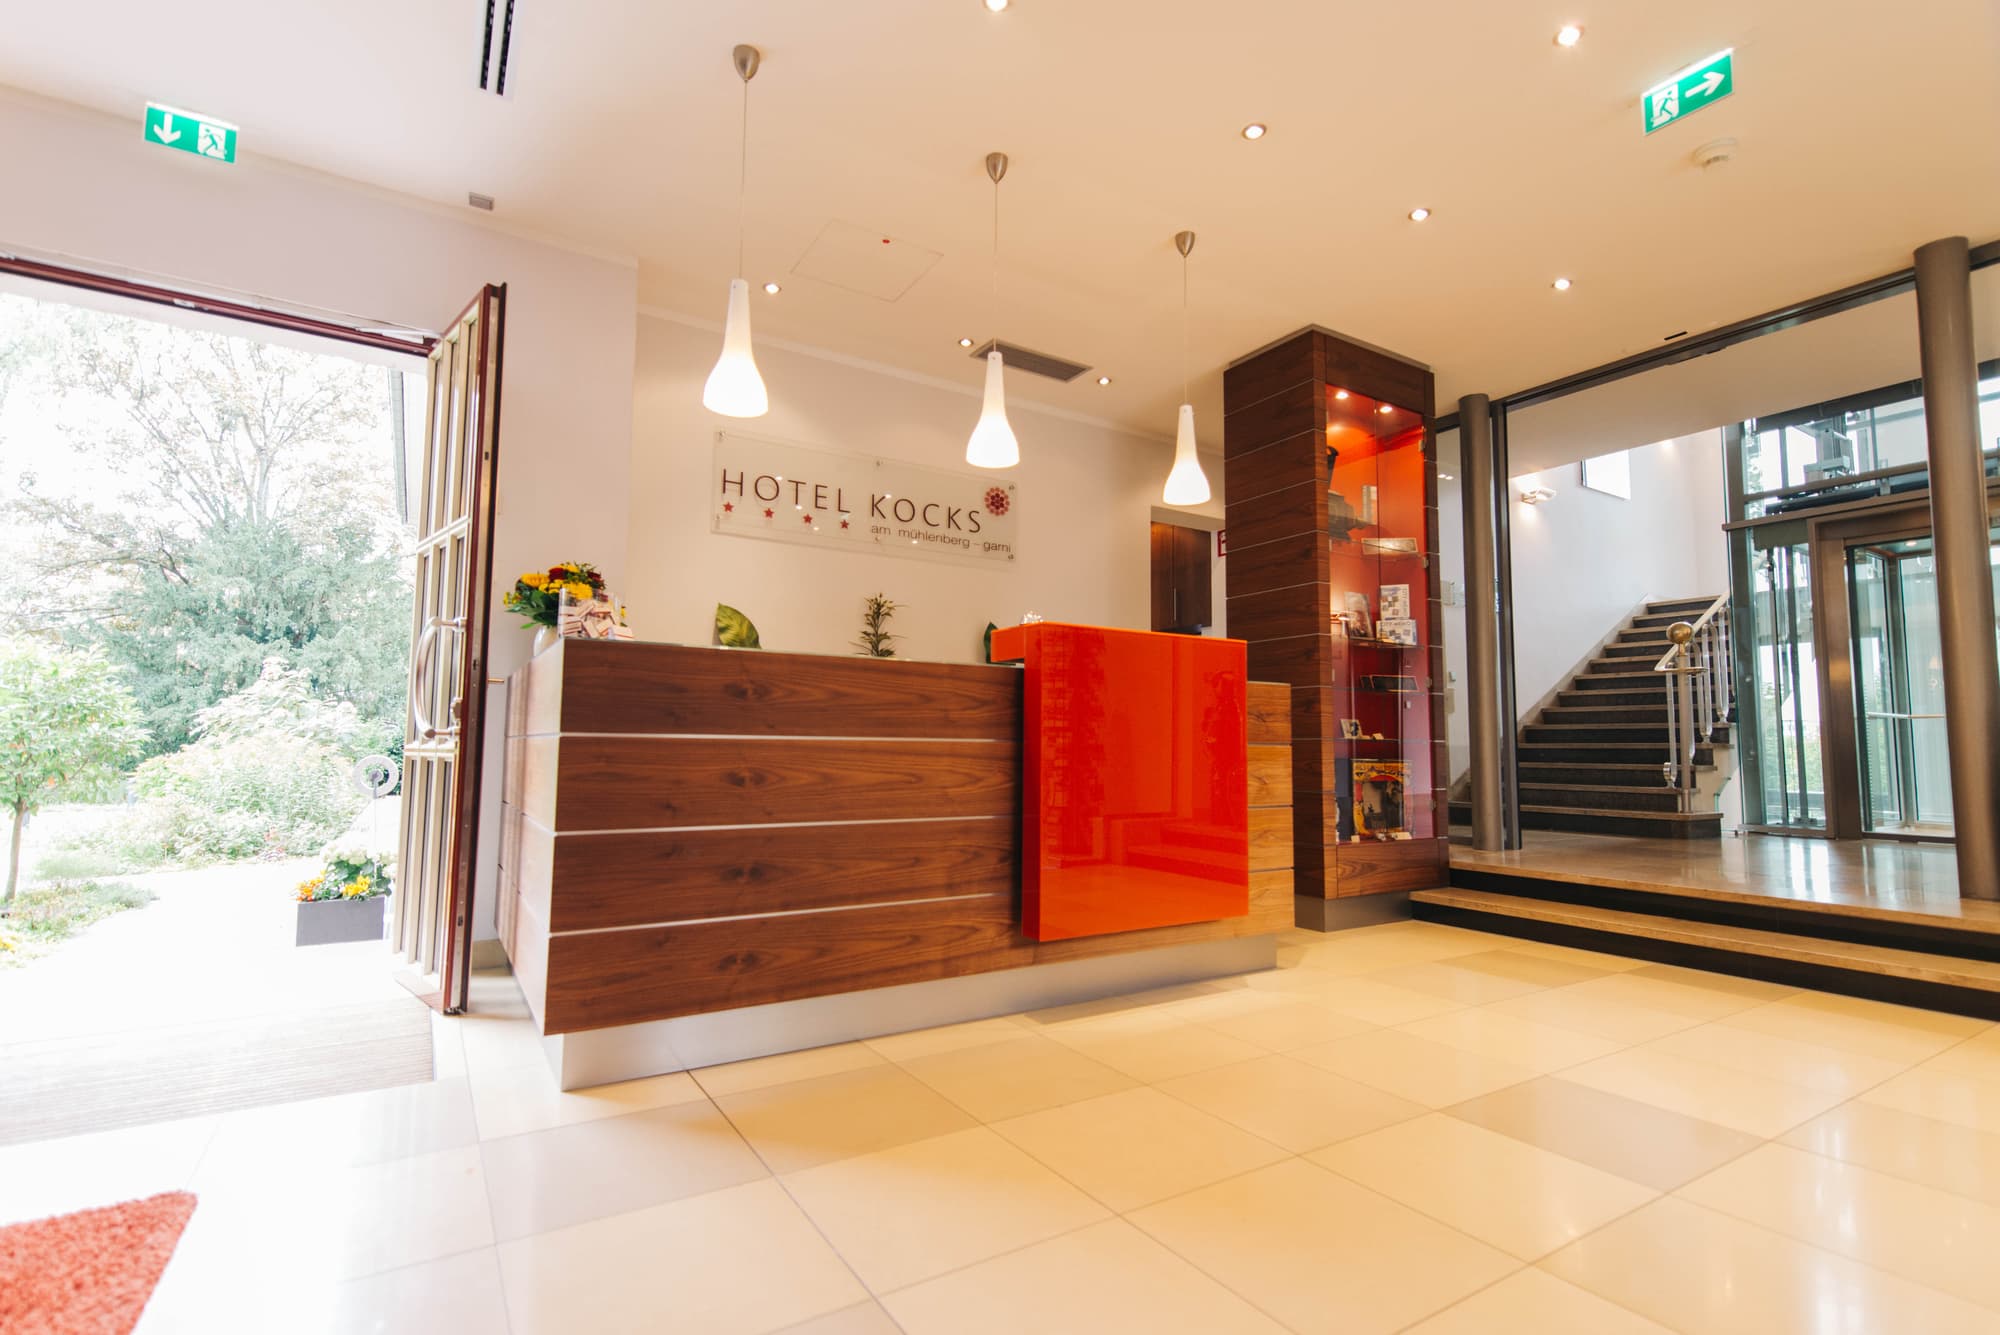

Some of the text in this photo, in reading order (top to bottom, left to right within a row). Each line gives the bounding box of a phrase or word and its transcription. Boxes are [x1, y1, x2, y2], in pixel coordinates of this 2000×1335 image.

[722, 468, 981, 533] HOTEL KOCKS
[871, 525, 891, 535] am
[898, 528, 970, 549] mühlenberg
[983, 541, 1011, 553] garni
